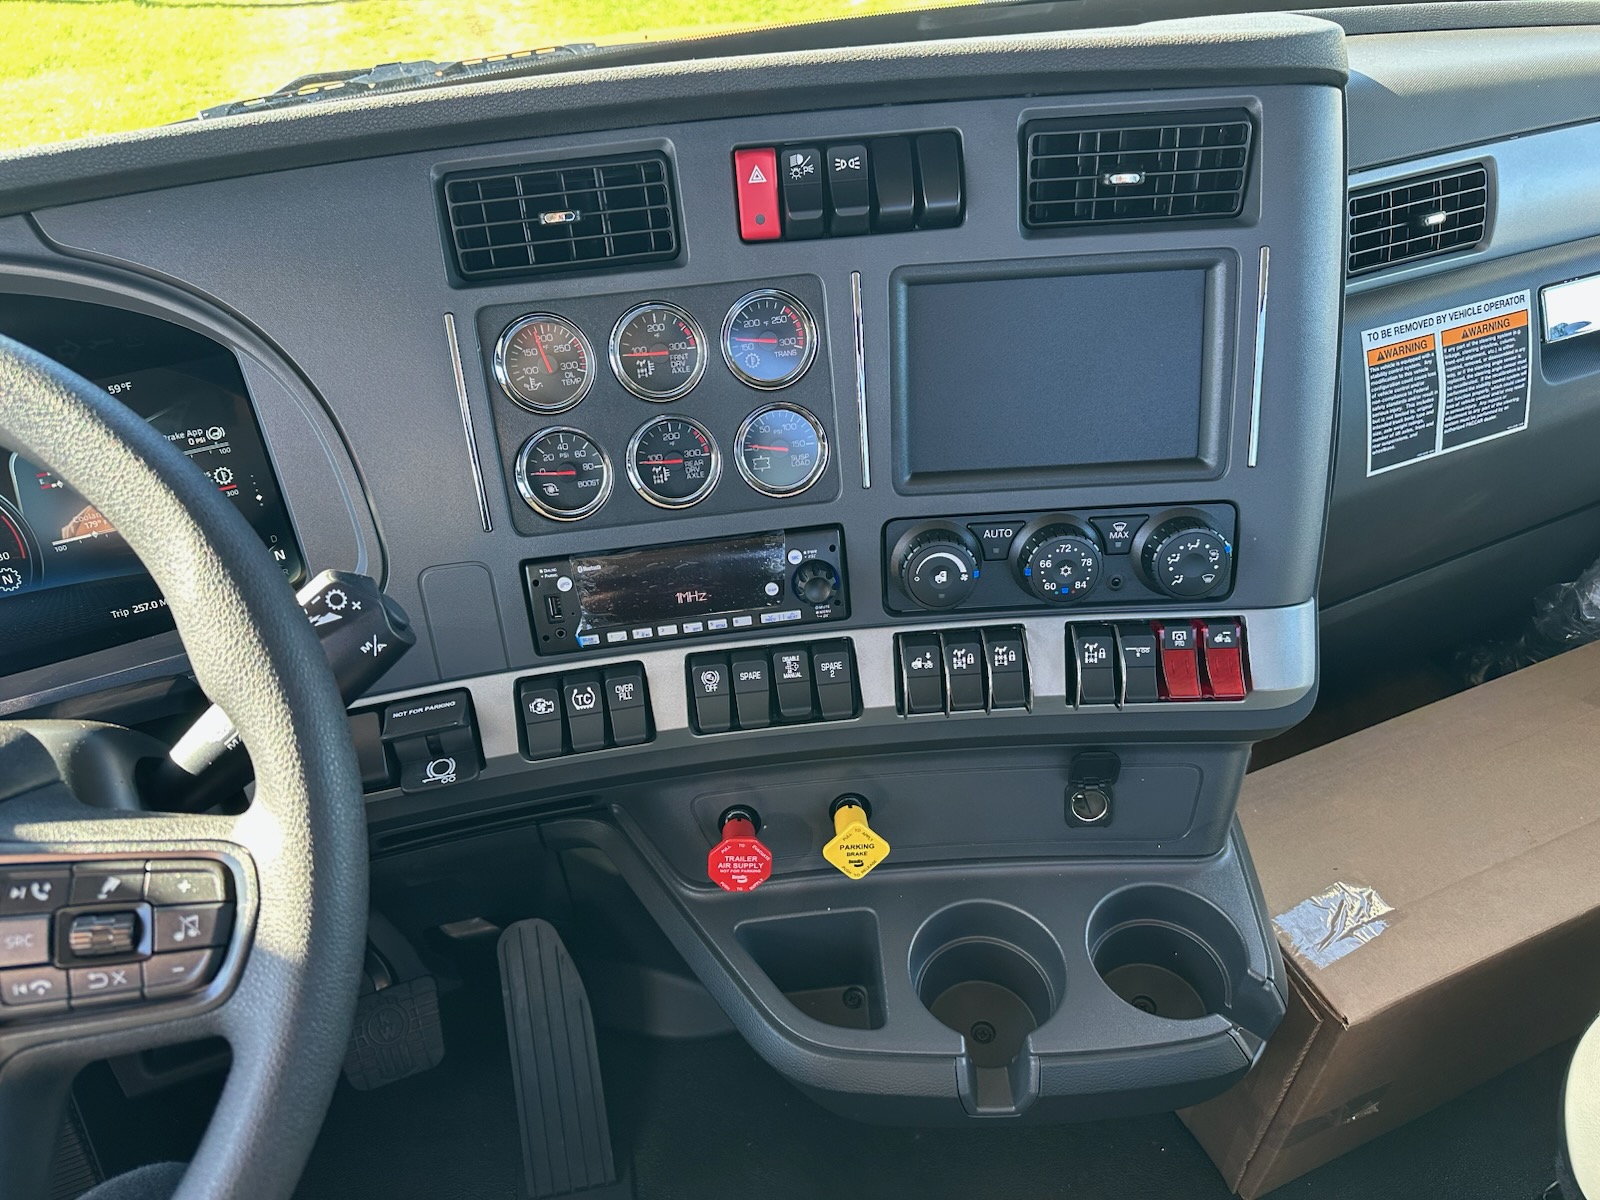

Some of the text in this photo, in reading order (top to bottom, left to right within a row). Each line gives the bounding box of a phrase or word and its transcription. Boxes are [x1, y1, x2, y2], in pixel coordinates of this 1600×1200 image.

[771, 316, 787, 324] 250
[1367, 295, 1525, 341] TO BE REMOVED BY VEHICLE OPERATOR
[647, 323, 665, 332] 200
[744, 319, 760, 328] 200
[1468, 319, 1510, 336] WARNING
[669, 342, 687, 350] 300
[780, 338, 796, 346] 300
[522, 348, 538, 356] 150
[553, 344, 571, 353] 250
[1384, 340, 1427, 358] WARNING
[561, 361, 578, 370] 300
[561, 378, 581, 386] TEMP
[108, 382, 132, 394] 59°F
[187, 429, 203, 437] App
[663, 432, 680, 441] 200
[684, 449, 701, 457] 300
[687, 471, 705, 479] AXLE
[578, 479, 600, 488] BOOST
[73, 512, 102, 523] Coolan
[983, 528, 1013, 539] AUTO
[1109, 530, 1129, 540] MAX
[270, 535, 277, 543] D
[1059, 544, 1072, 553] 72
[274, 550, 286, 560] N
[1040, 559, 1052, 568] 66
[1081, 558, 1092, 567] 78
[2, 575, 13, 584] N
[1044, 582, 1056, 590] 60
[1075, 581, 1087, 589] 84
[110, 609, 129, 618] Trip
[132, 601, 158, 613] 257.0
[821, 662, 842, 671] SPARE
[740, 671, 761, 681] SPARE
[615, 684, 634, 694] OVER
[705, 684, 718, 692] OFF
[577, 694, 592, 706] TC
[618, 692, 633, 701] FILL
[393, 710, 408, 718] NOT
[425, 701, 456, 711] PARKING
